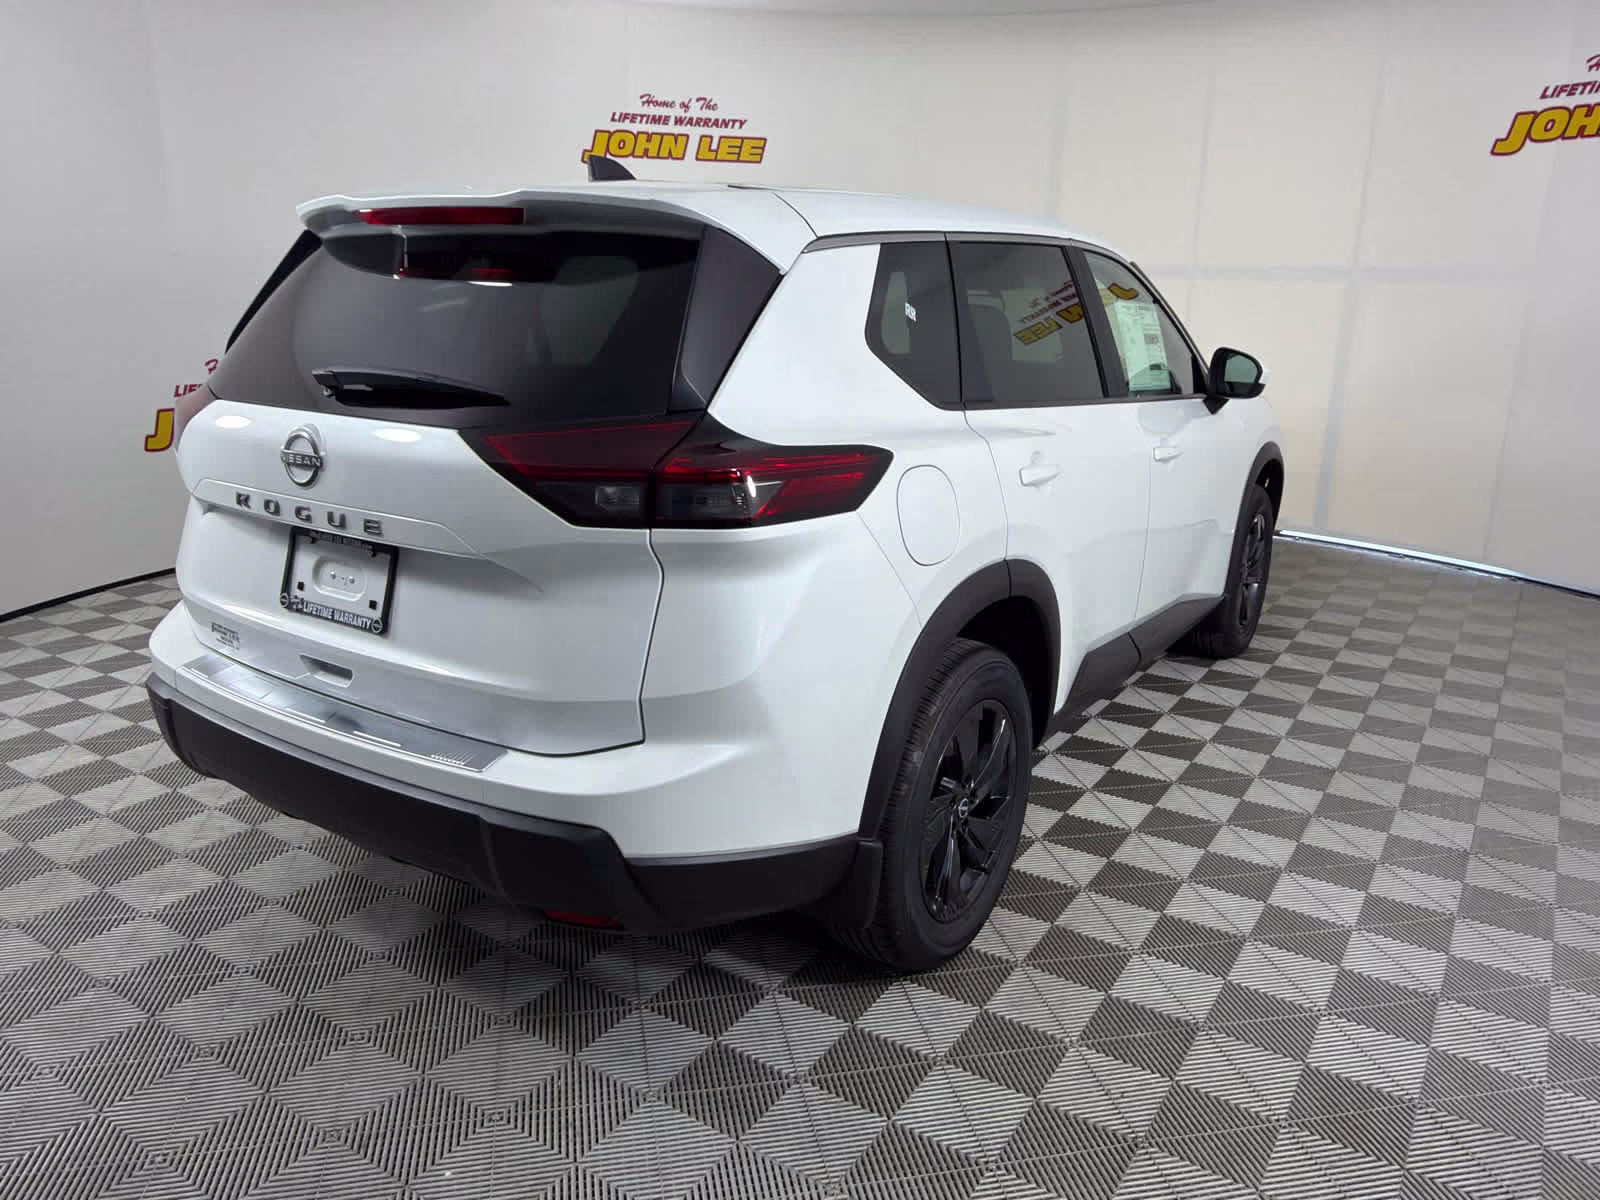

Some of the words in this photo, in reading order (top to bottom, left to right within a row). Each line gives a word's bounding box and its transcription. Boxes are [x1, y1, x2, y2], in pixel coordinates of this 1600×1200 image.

[639, 93, 675, 109] Home
[679, 97, 692, 113] of
[695, 97, 718, 111] The
[610, 112, 671, 126] LIFETIME
[674, 115, 748, 130] WARRANTY
[581, 129, 689, 163] JOHN
[695, 135, 767, 164] LEE
[236, 492, 384, 538] ROGUE
[303, 600, 333, 619] LIFETIME
[333, 608, 372, 629] WARRANTY
